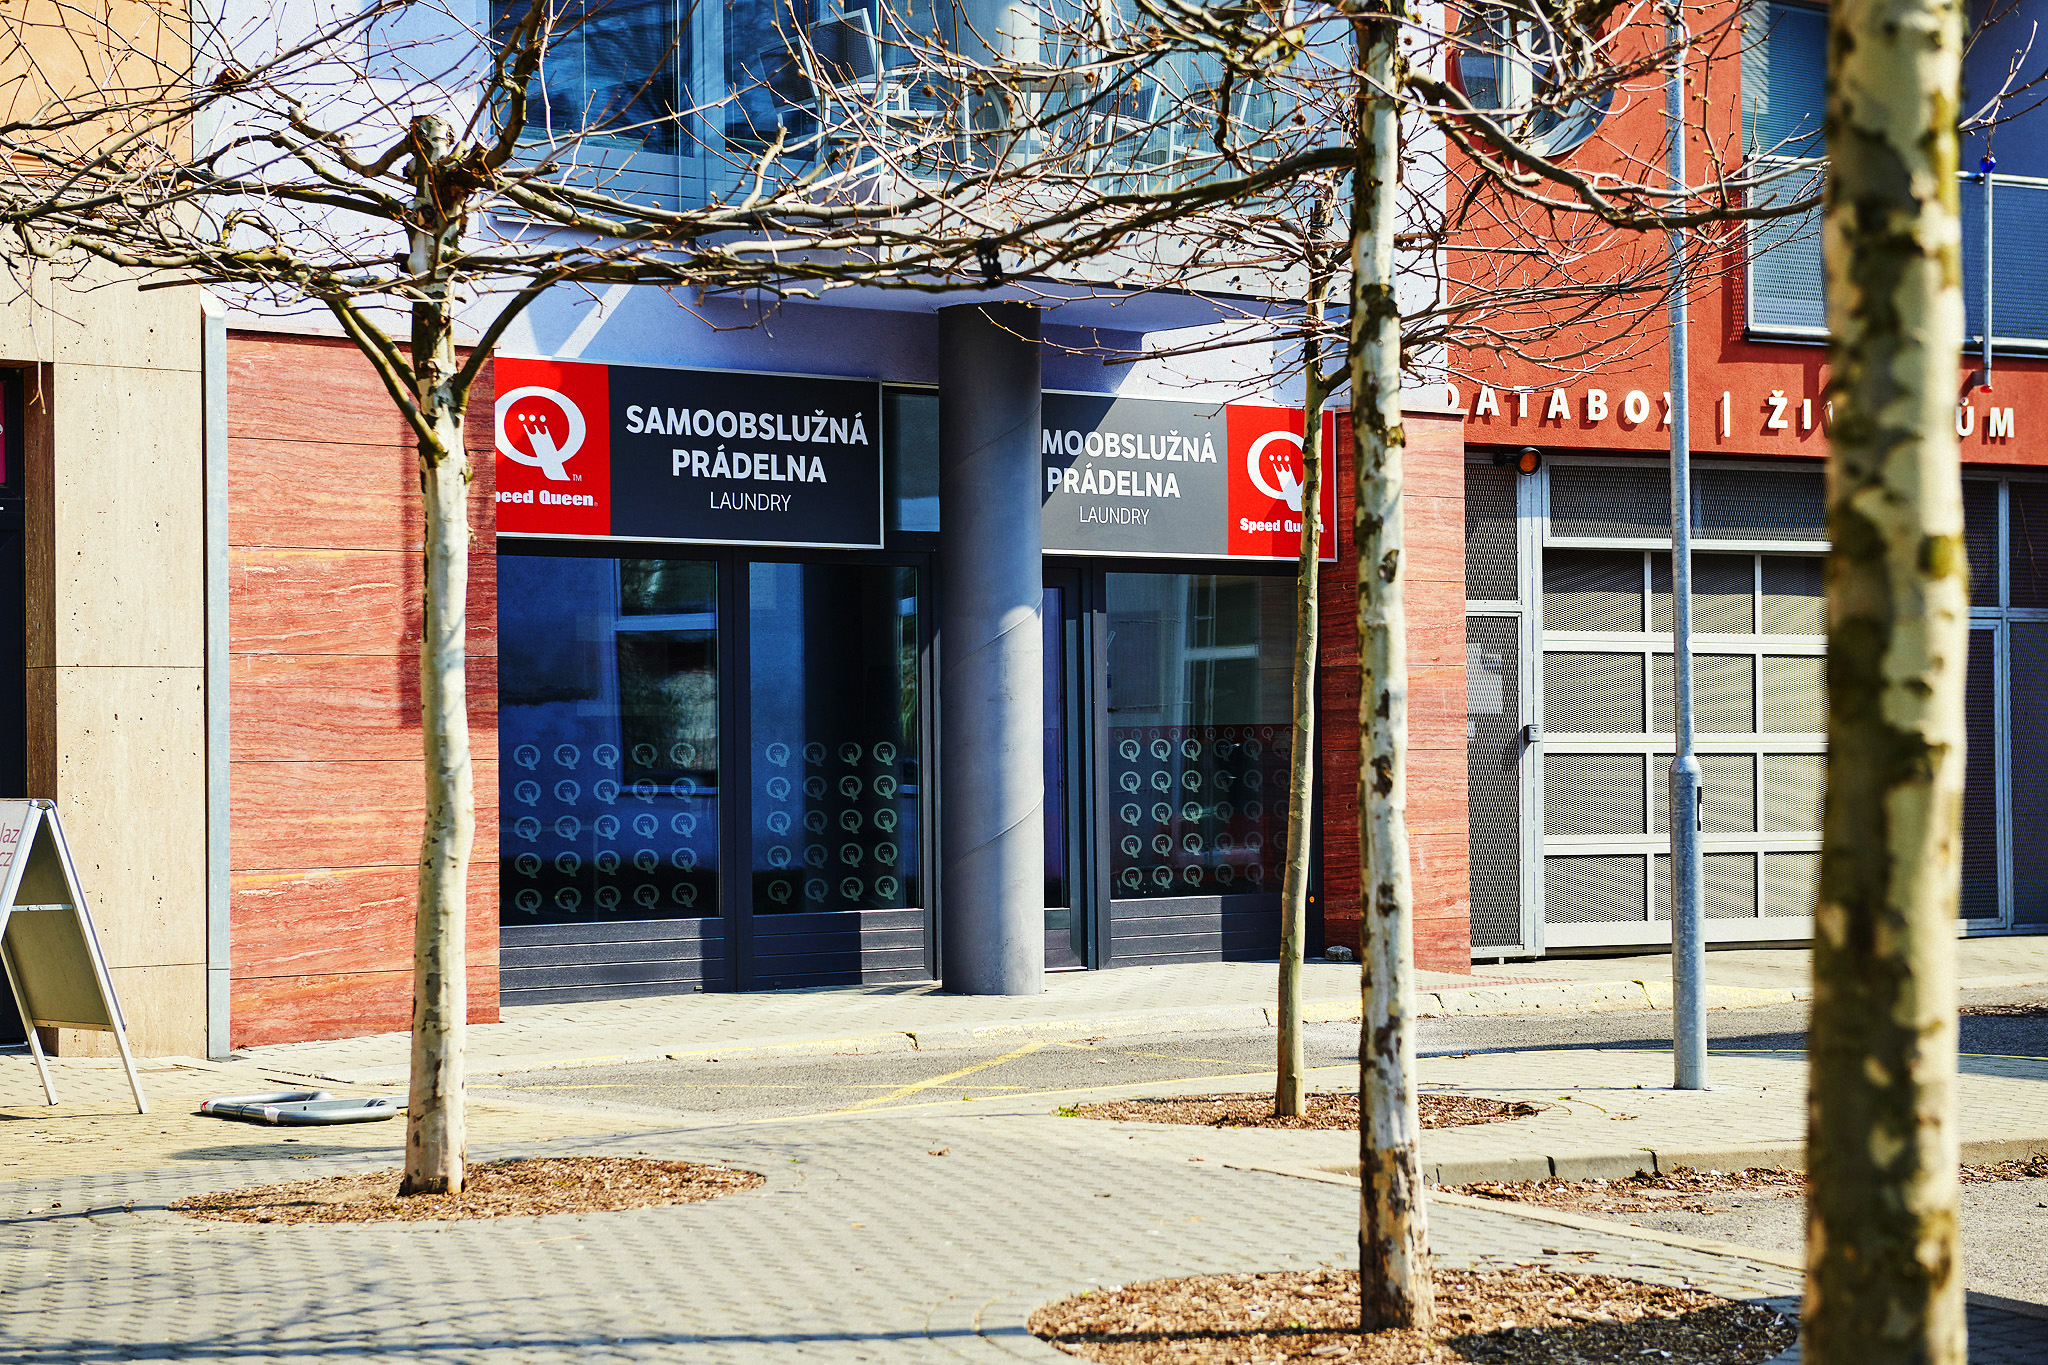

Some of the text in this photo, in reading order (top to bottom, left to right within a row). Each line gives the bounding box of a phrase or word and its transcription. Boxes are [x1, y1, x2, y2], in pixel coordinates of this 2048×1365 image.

[626, 405, 869, 446] SAMOOBSLUŽNÁ
[1042, 429, 1218, 464] MOOBSLUŽNÁ
[672, 444, 827, 483] PRÁDELNA
[1047, 462, 1182, 499] PRÁDELNA
[539, 489, 594, 506] Queen
[710, 491, 791, 512] LAUNDRY
[1079, 505, 1150, 525] LAUNDRY
[1240, 517, 1281, 534] Speed
